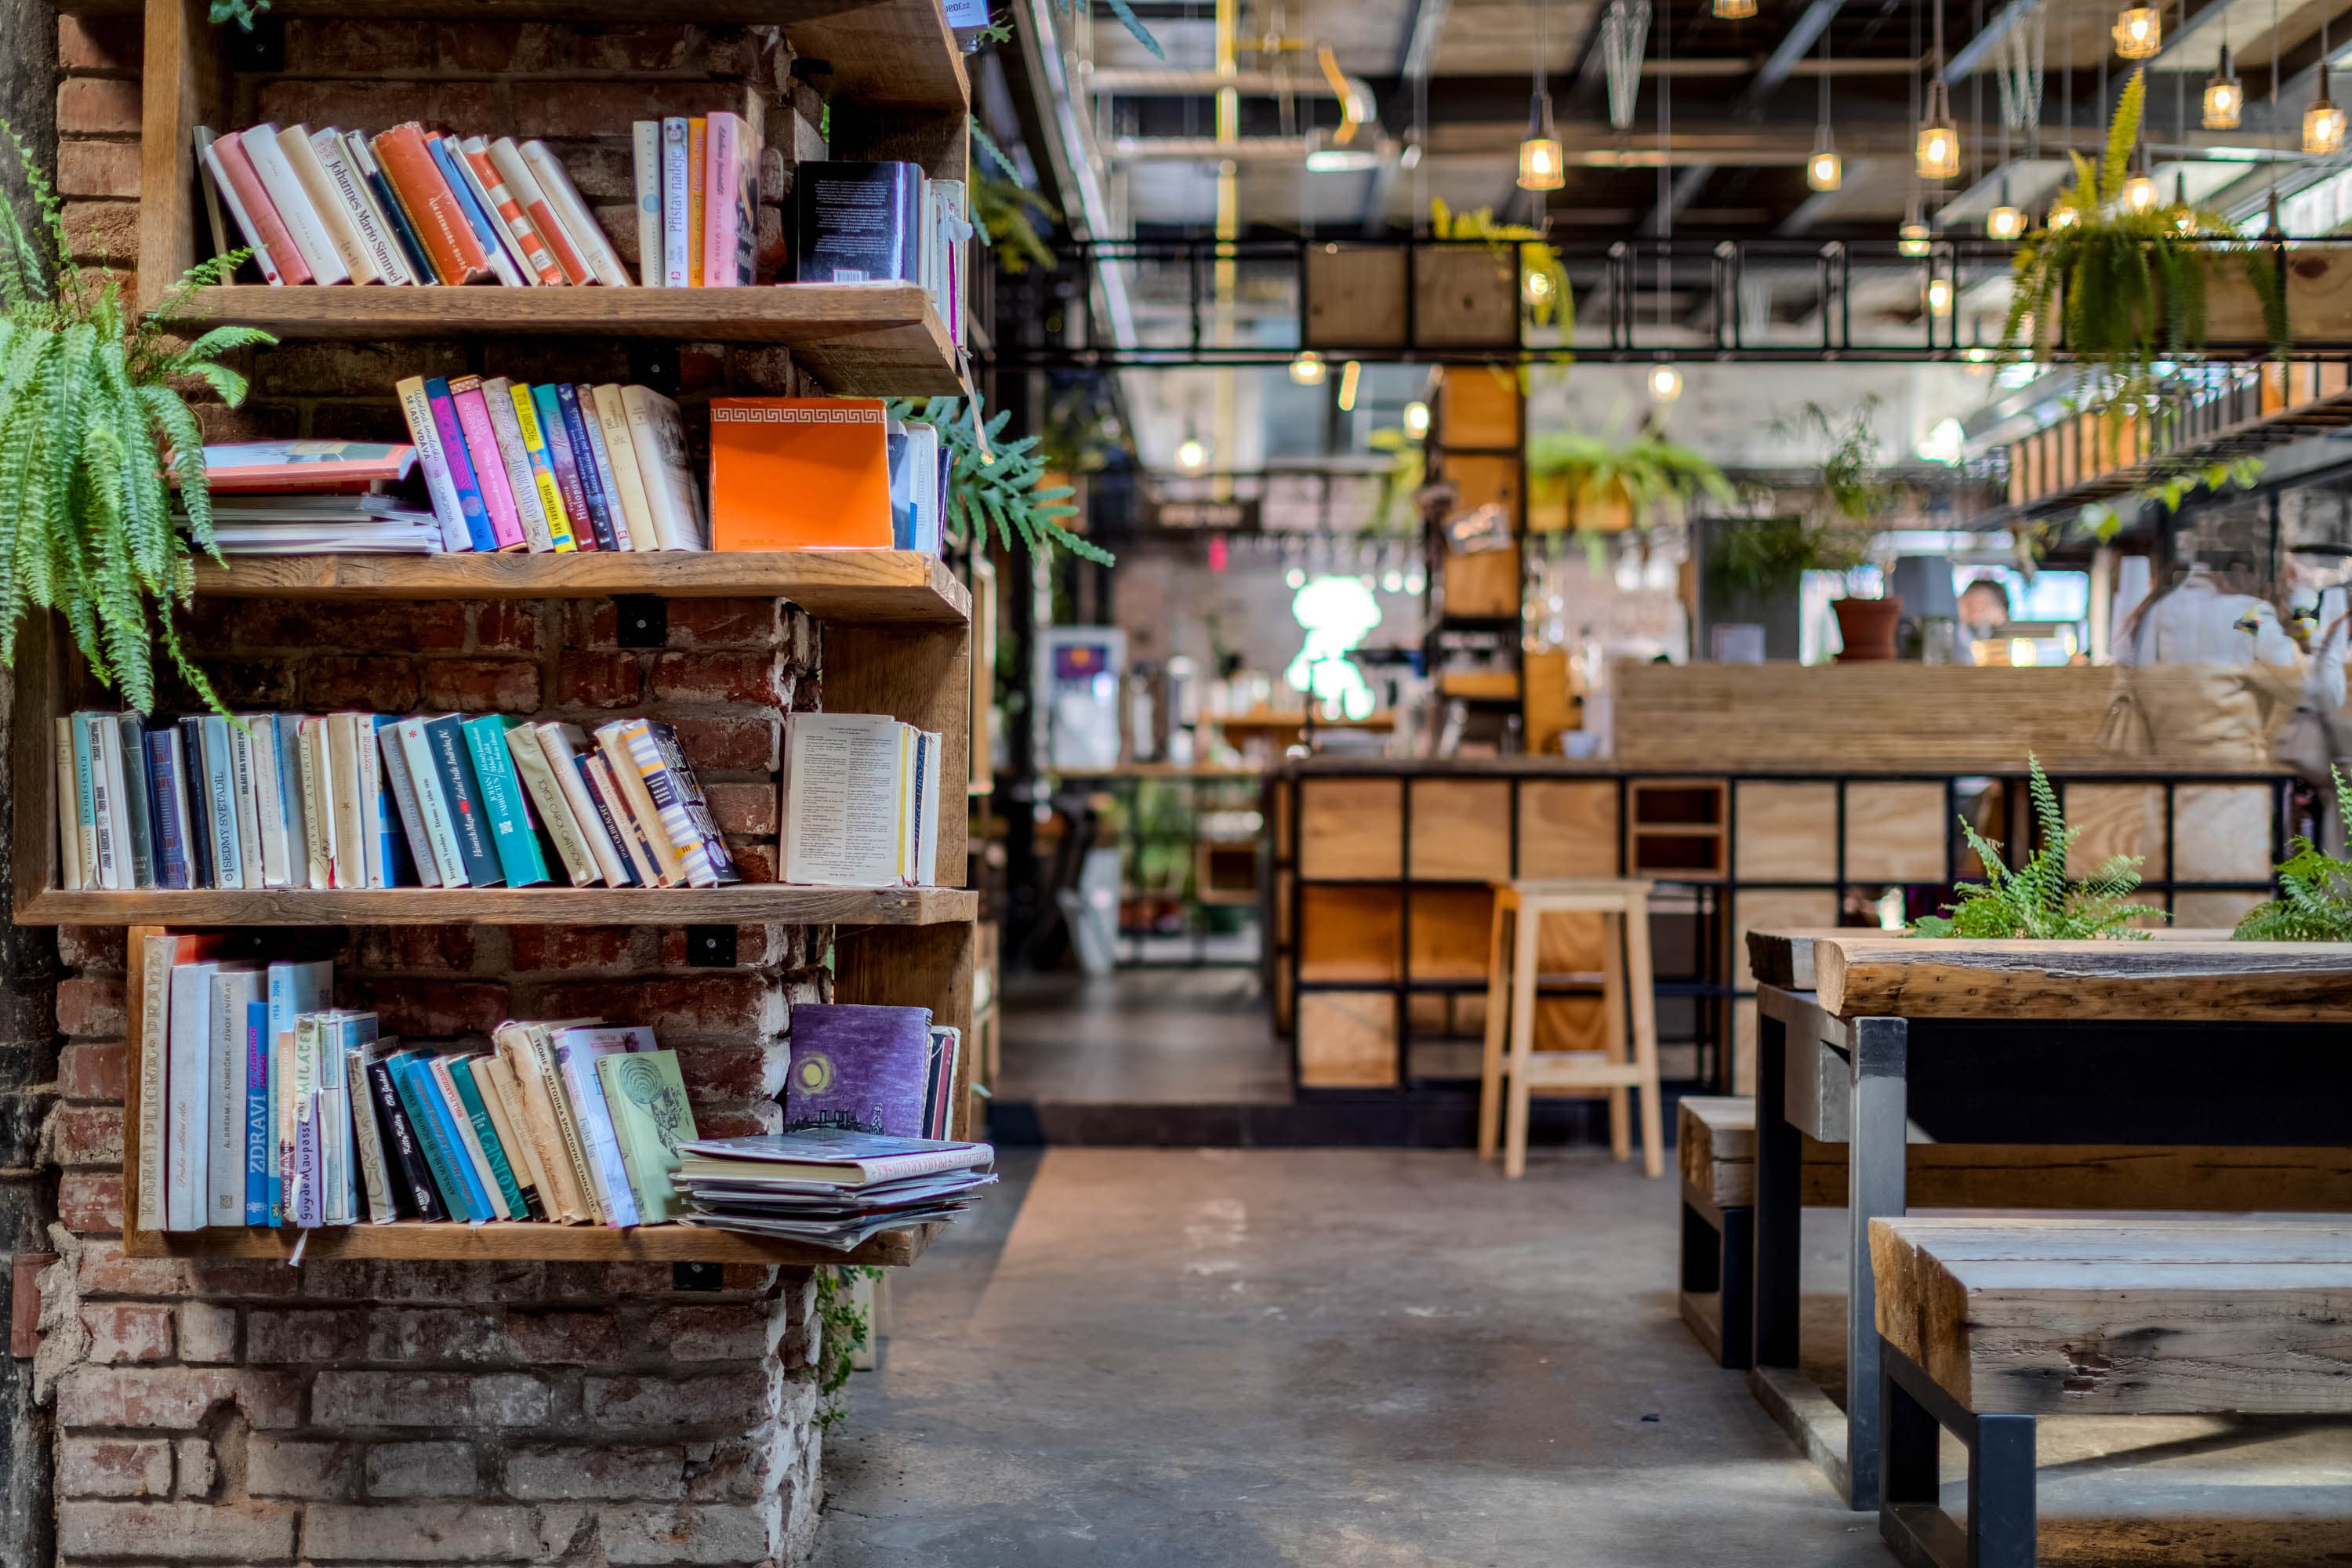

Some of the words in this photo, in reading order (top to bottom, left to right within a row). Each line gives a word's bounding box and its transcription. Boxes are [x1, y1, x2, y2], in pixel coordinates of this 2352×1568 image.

[667, 151, 683, 190] naděje
[326, 158, 365, 212] Johannes
[354, 209, 381, 244] Mario
[371, 240, 403, 284] Simmel
[668, 192, 684, 232] Přístav
[435, 211, 455, 245] ERENBURG
[405, 394, 414, 405] SE
[408, 406, 421, 427] (ASI)
[412, 388, 430, 423] Úspěšná
[423, 424, 441, 463] smolařka
[568, 406, 584, 440] hvězdách
[415, 429, 432, 461] VDÁVÁ
[568, 428, 580, 454] Allenová
[579, 439, 589, 450] po
[575, 455, 586, 479] Addison
[432, 468, 442, 485] MEG
[437, 485, 455, 522] CABOTOVÁ
[564, 473, 587, 520] Hislopová
[598, 462, 619, 506] DOKTORKA
[540, 482, 561, 521] VAVŘINCOVÁ
[562, 485, 575, 512] Victoria
[553, 520, 564, 534] FAN
[237, 741, 246, 762] VINICI
[299, 731, 314, 797] VZPOMÍNKY
[239, 762, 247, 772] NA
[211, 769, 230, 826] SVĚTADÍL
[424, 789, 434, 802] jeho
[481, 775, 499, 803] JOHAN
[488, 776, 512, 817] FABRICIUS
[96, 799, 107, 811] Tajný
[537, 779, 554, 803] JOYCE
[548, 802, 566, 829] CAROL
[595, 801, 623, 844] OLBRACHT
[98, 828, 110, 852] FABRICIUS
[217, 827, 234, 868] SEDMÝ
[437, 832, 449, 856] Vorobjov
[466, 830, 483, 858] Heinrich
[616, 843, 628, 859] IVAN
[101, 852, 111, 869] JOHAN
[444, 858, 456, 880] Jevgenij
[223, 982, 232, 1014] ZVÍŘAT
[272, 978, 281, 996] 2006
[250, 1076, 256, 1088] ve
[258, 1053, 267, 1089] rukách
[434, 1061, 456, 1102] FLANDERSOVÁ
[143, 1049, 160, 1136] PLICKA
[391, 1112, 406, 1137] Kelley
[452, 1102, 463, 1119] MOLL
[248, 1094, 266, 1173] ZDRAVÍ
[532, 1038, 548, 1066] TEORIE
[546, 1074, 565, 1116] METODIKA
[560, 1116, 582, 1163] SPORTOVNÍ
[575, 1163, 599, 1214] GYMNASTIKY
[576, 1116, 594, 1143] Fight
[586, 1143, 599, 1160] Fat
[399, 1134, 412, 1155] Kitty
[176, 1159, 186, 1187] Praha
[430, 1151, 446, 1176] MARIA
[140, 1140, 158, 1216] KAREL
[299, 1182, 309, 1195] de
[441, 1175, 455, 1196] ANNA
[299, 1199, 312, 1219] Guy
[415, 1190, 426, 1206] IRIS
